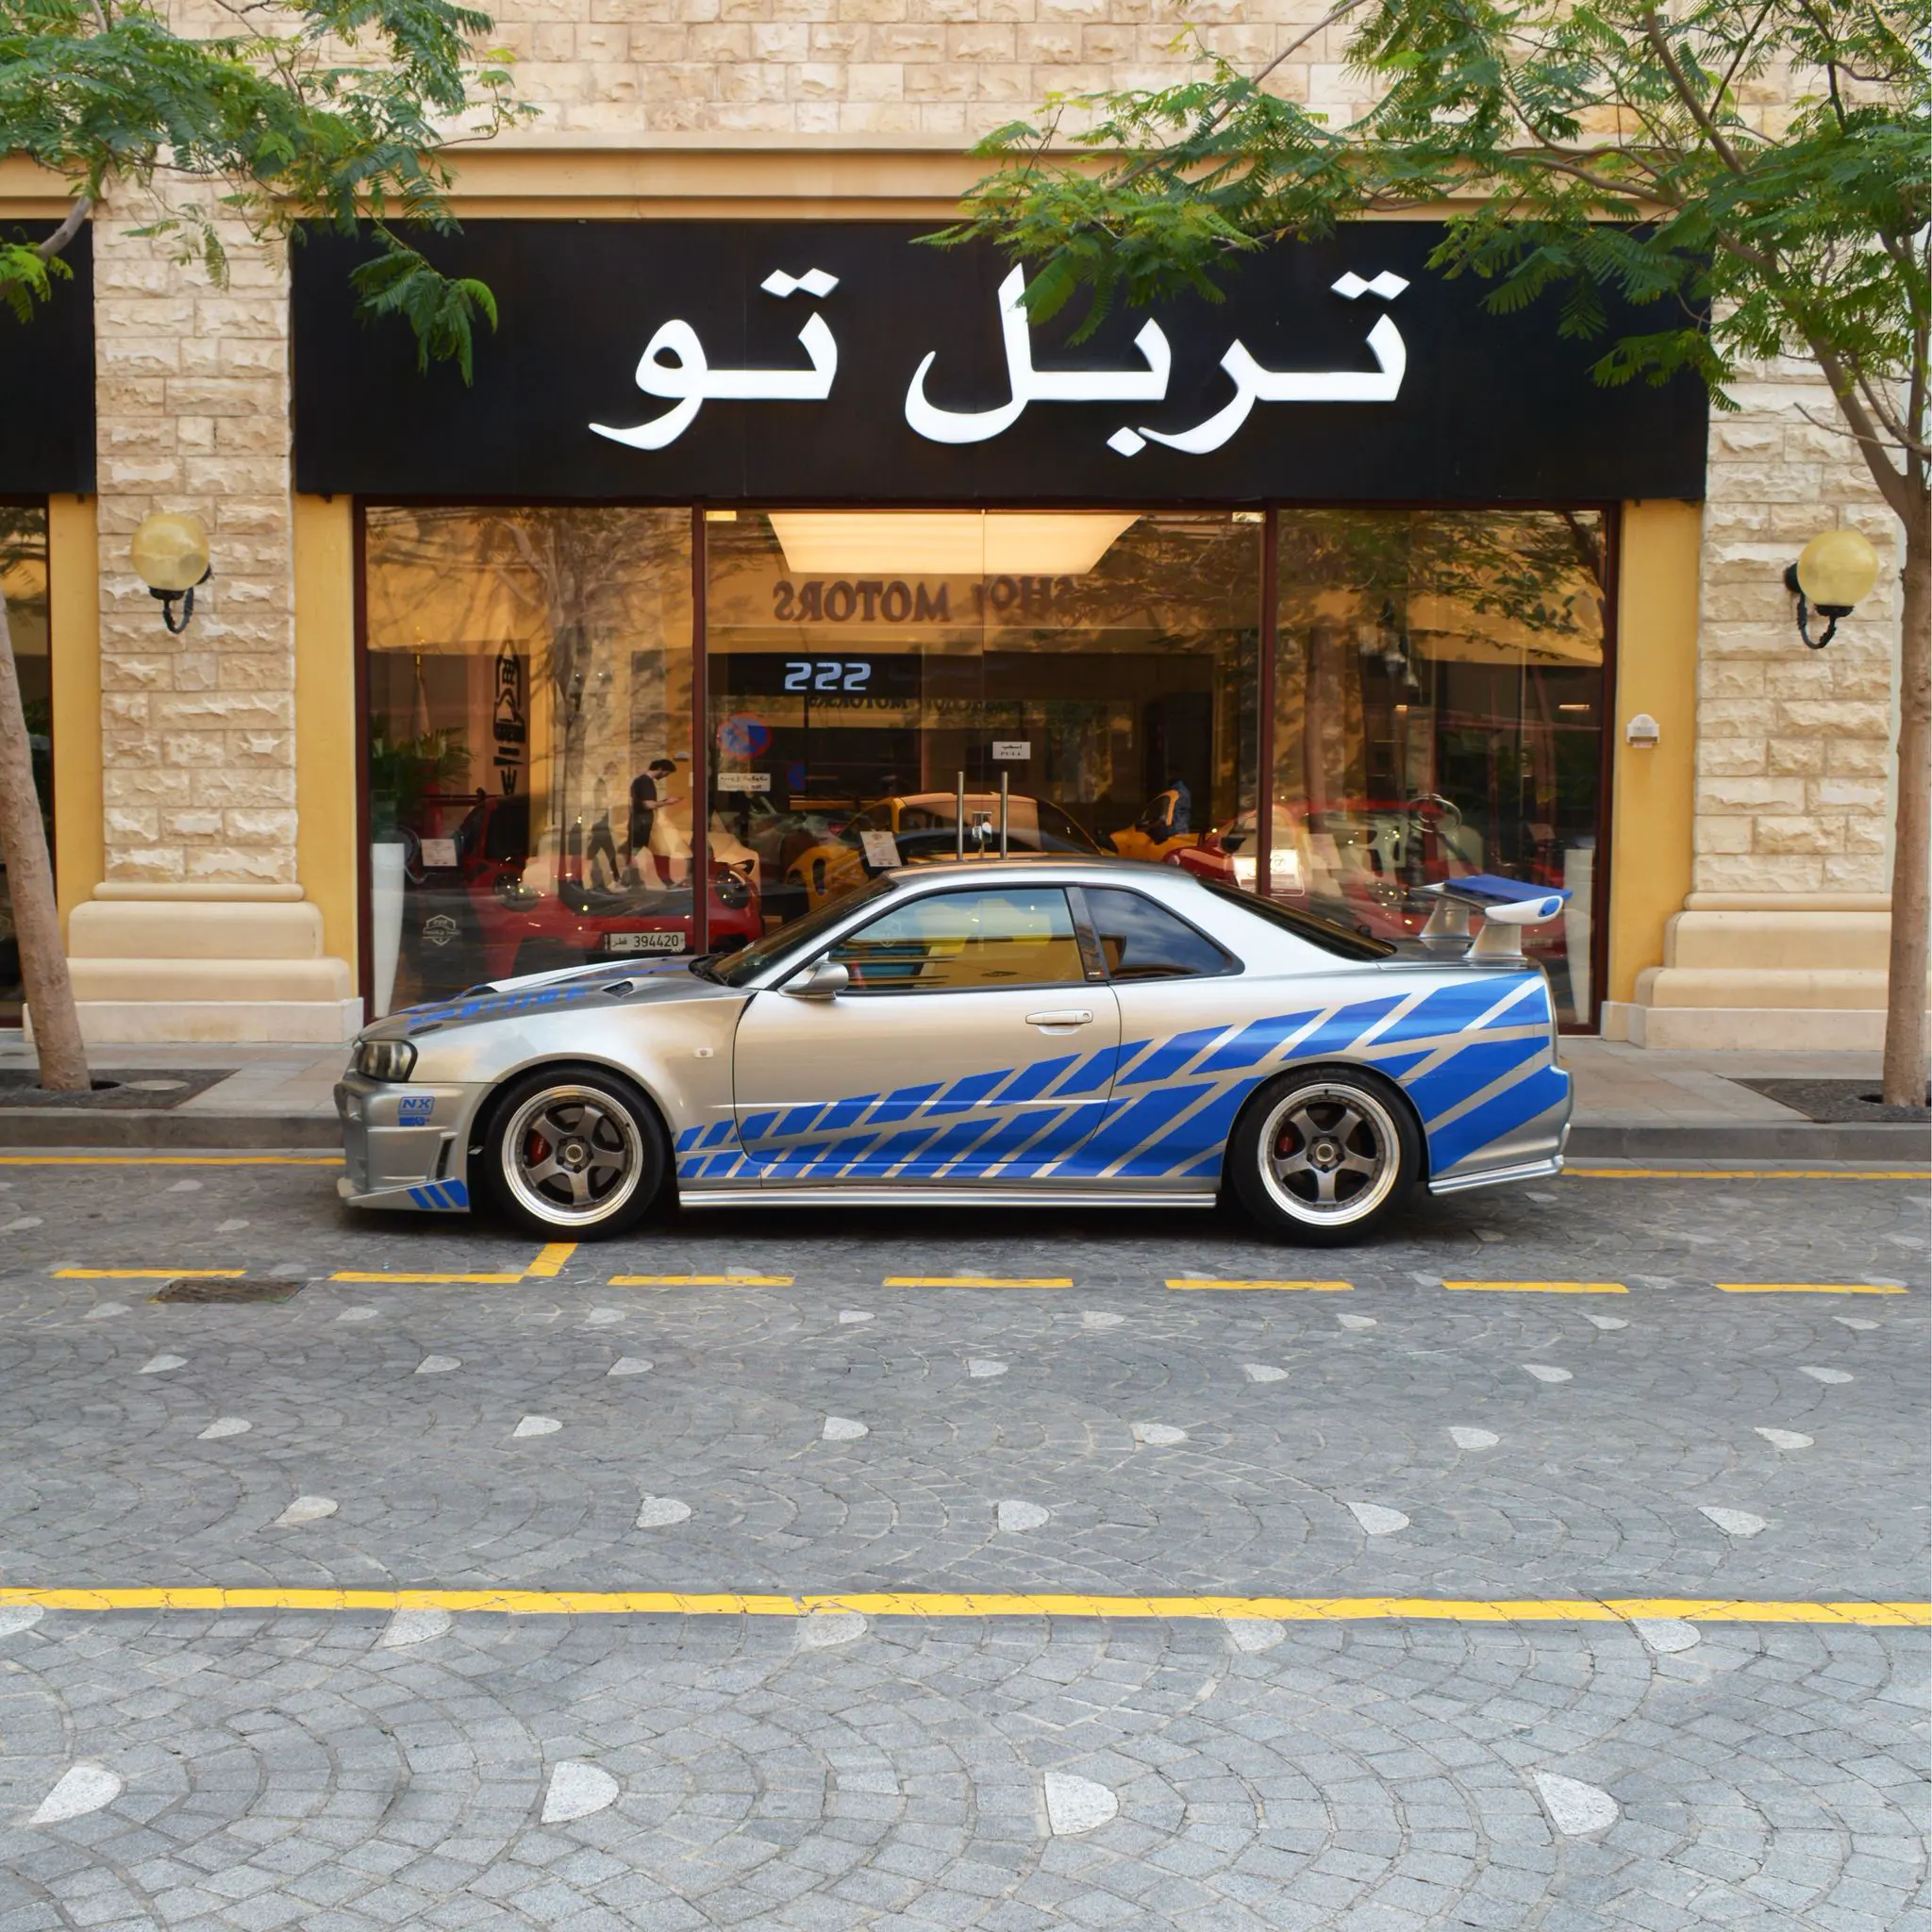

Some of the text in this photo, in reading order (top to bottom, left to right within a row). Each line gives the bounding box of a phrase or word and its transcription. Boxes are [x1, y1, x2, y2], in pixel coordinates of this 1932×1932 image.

[589, 262, 1410, 458] تربل تو
[784, 662, 872, 690] 222
[633, 935, 679, 948] 394420
[402, 1098, 432, 1109] NX
